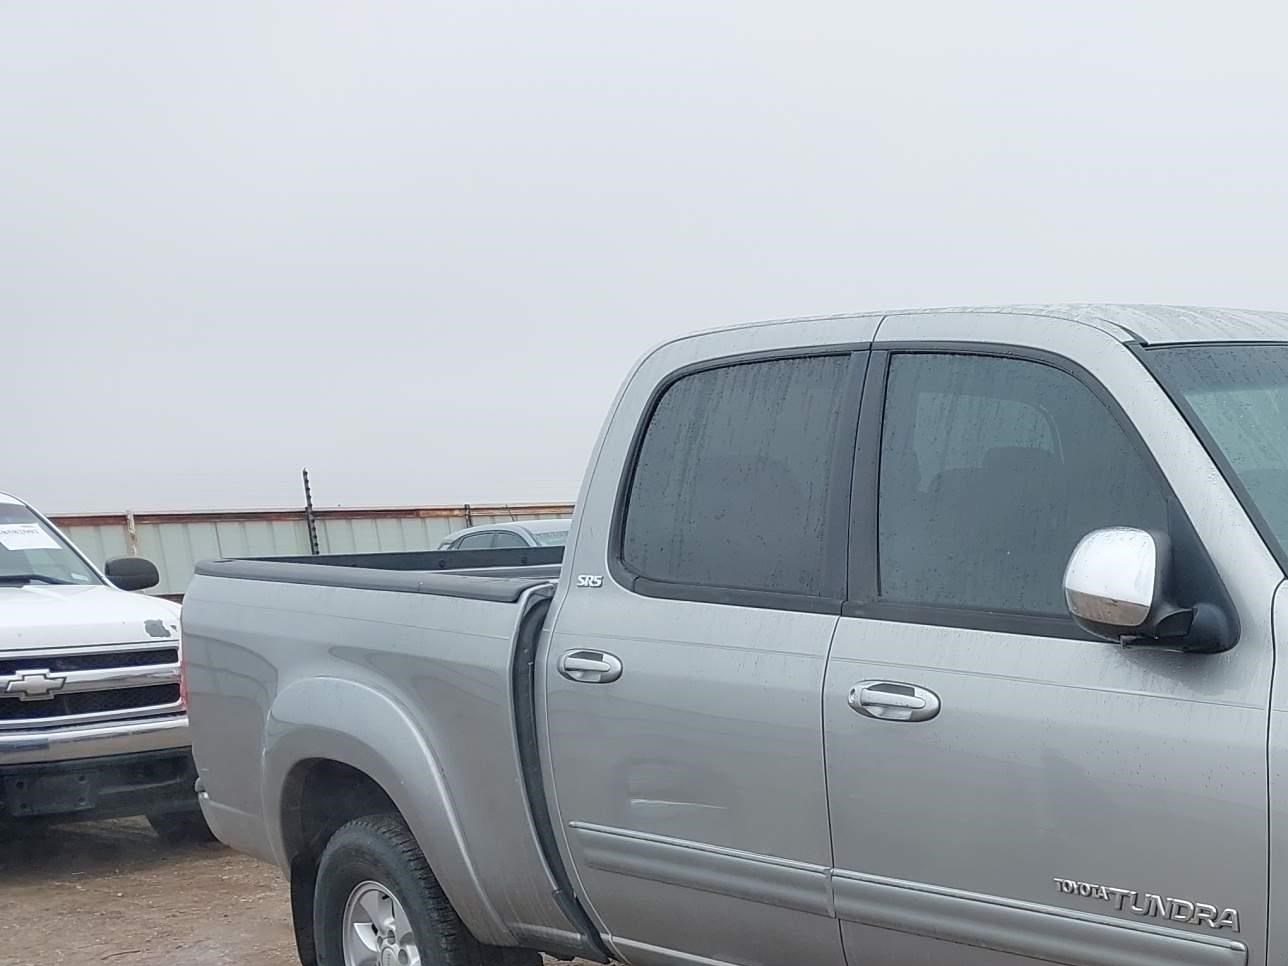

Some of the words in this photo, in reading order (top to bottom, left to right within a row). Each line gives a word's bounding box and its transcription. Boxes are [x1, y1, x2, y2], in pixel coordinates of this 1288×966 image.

[576, 574, 604, 588] SR5
[1053, 877, 1111, 901] TOYOTA
[1109, 887, 1241, 933] TUNDRA
